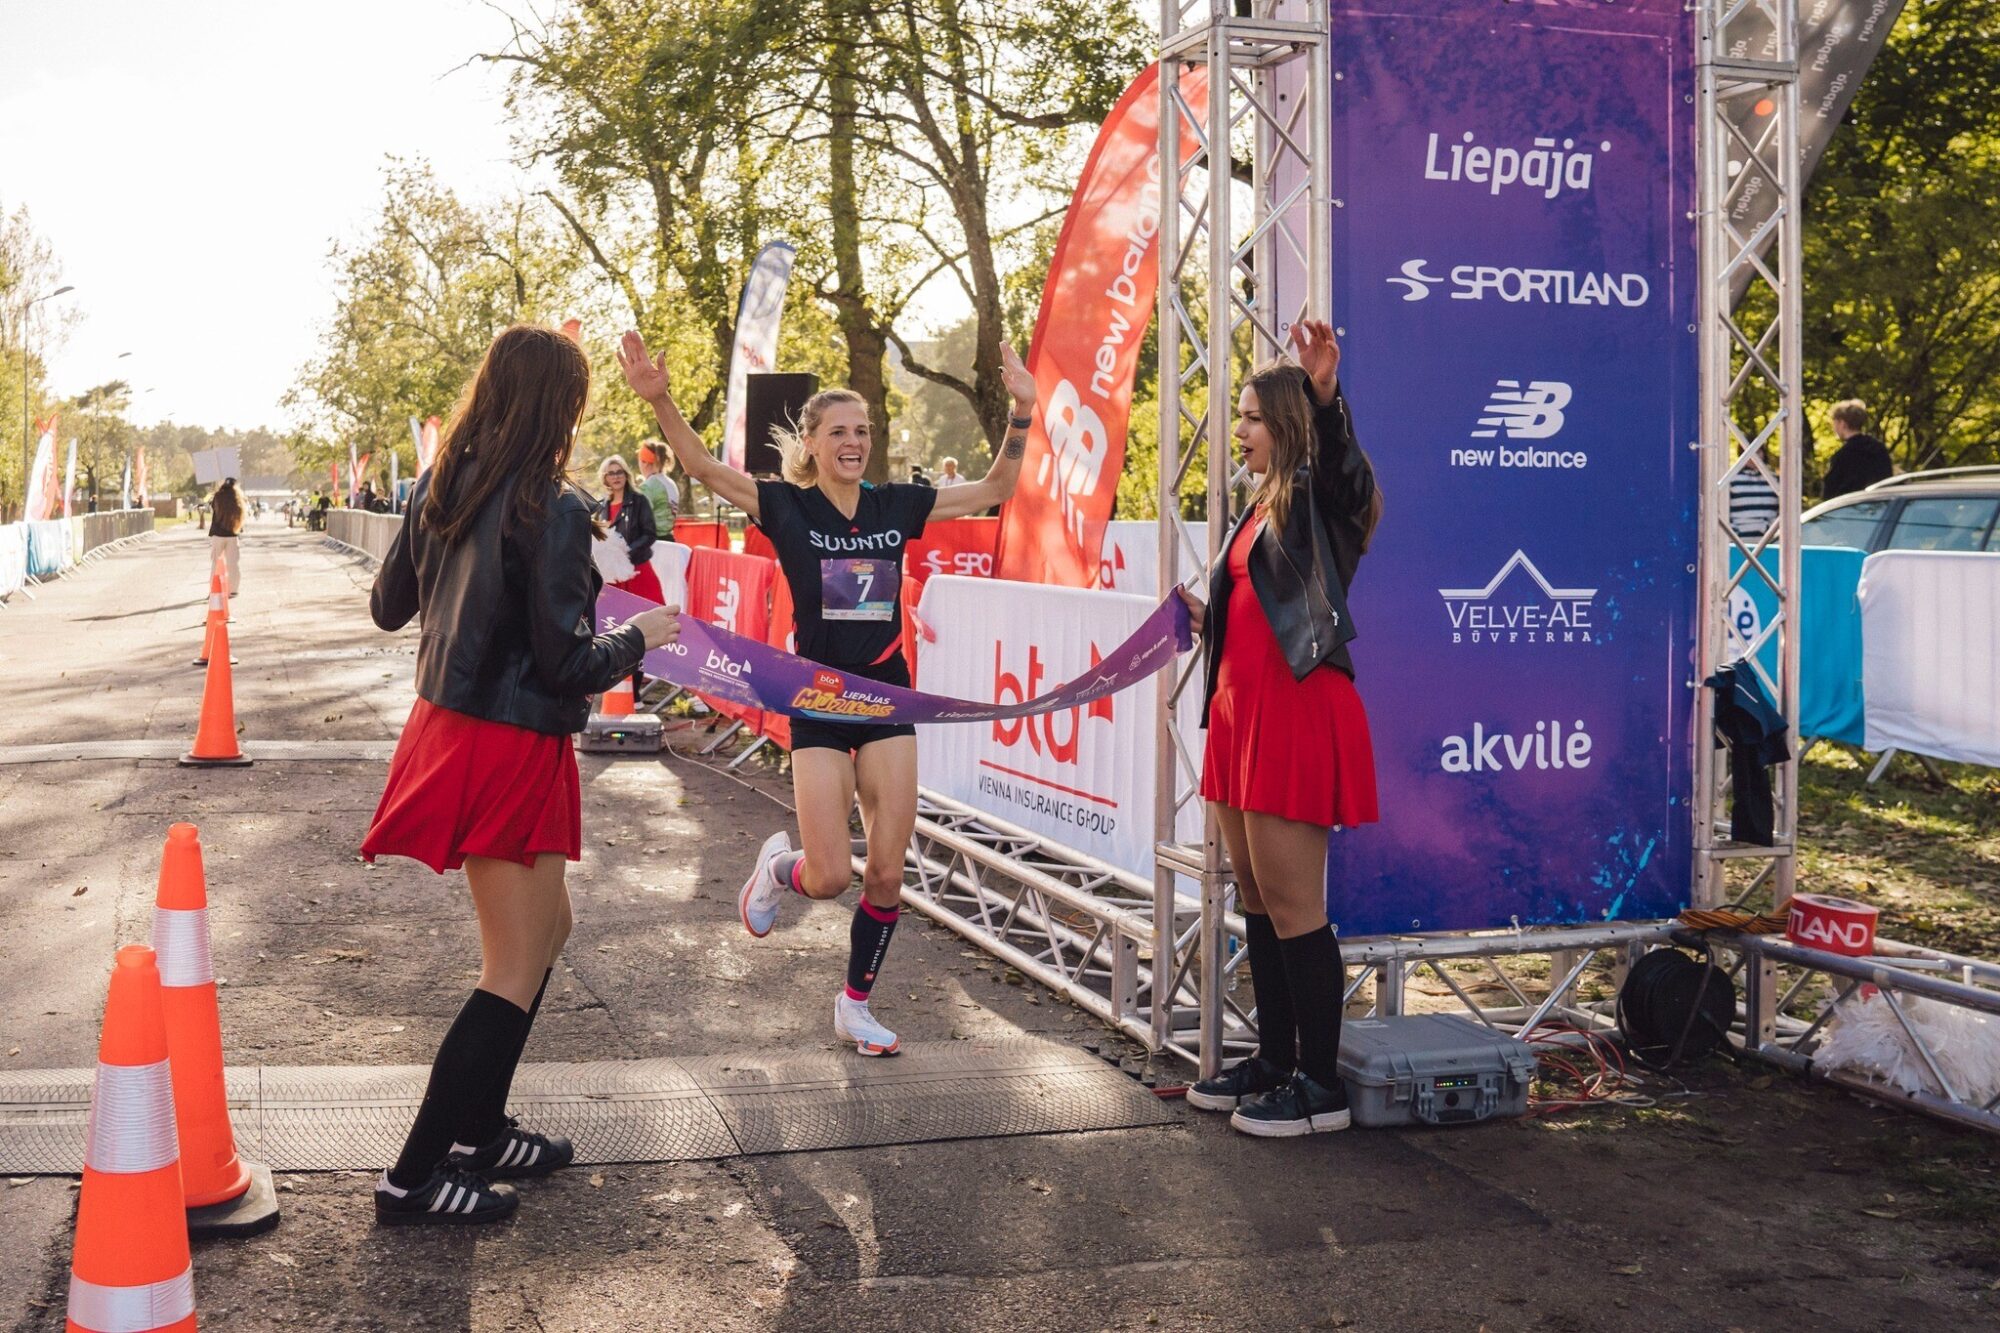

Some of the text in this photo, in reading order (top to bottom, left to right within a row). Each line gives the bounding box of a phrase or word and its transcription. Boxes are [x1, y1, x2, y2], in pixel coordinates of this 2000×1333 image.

[1425, 131, 1593, 199] Liepāja
[1090, 138, 1160, 399] new balanc
[1451, 265, 1650, 307] SPORTLAND
[1451, 446, 1587, 469] new balance
[809, 529, 901, 551] SUUNTO
[857, 574, 874, 603] 7
[1445, 601, 1592, 629] VELVE-AE
[1453, 630, 1592, 643] BŪVFIRMA
[706, 649, 742, 677] bta
[842, 690, 891, 705] LIEPĀJAS
[993, 639, 1078, 765] bta
[1441, 719, 1592, 773] akvilė
[978, 774, 1012, 802] VIENNA
[1014, 785, 1074, 824] INSURANCE
